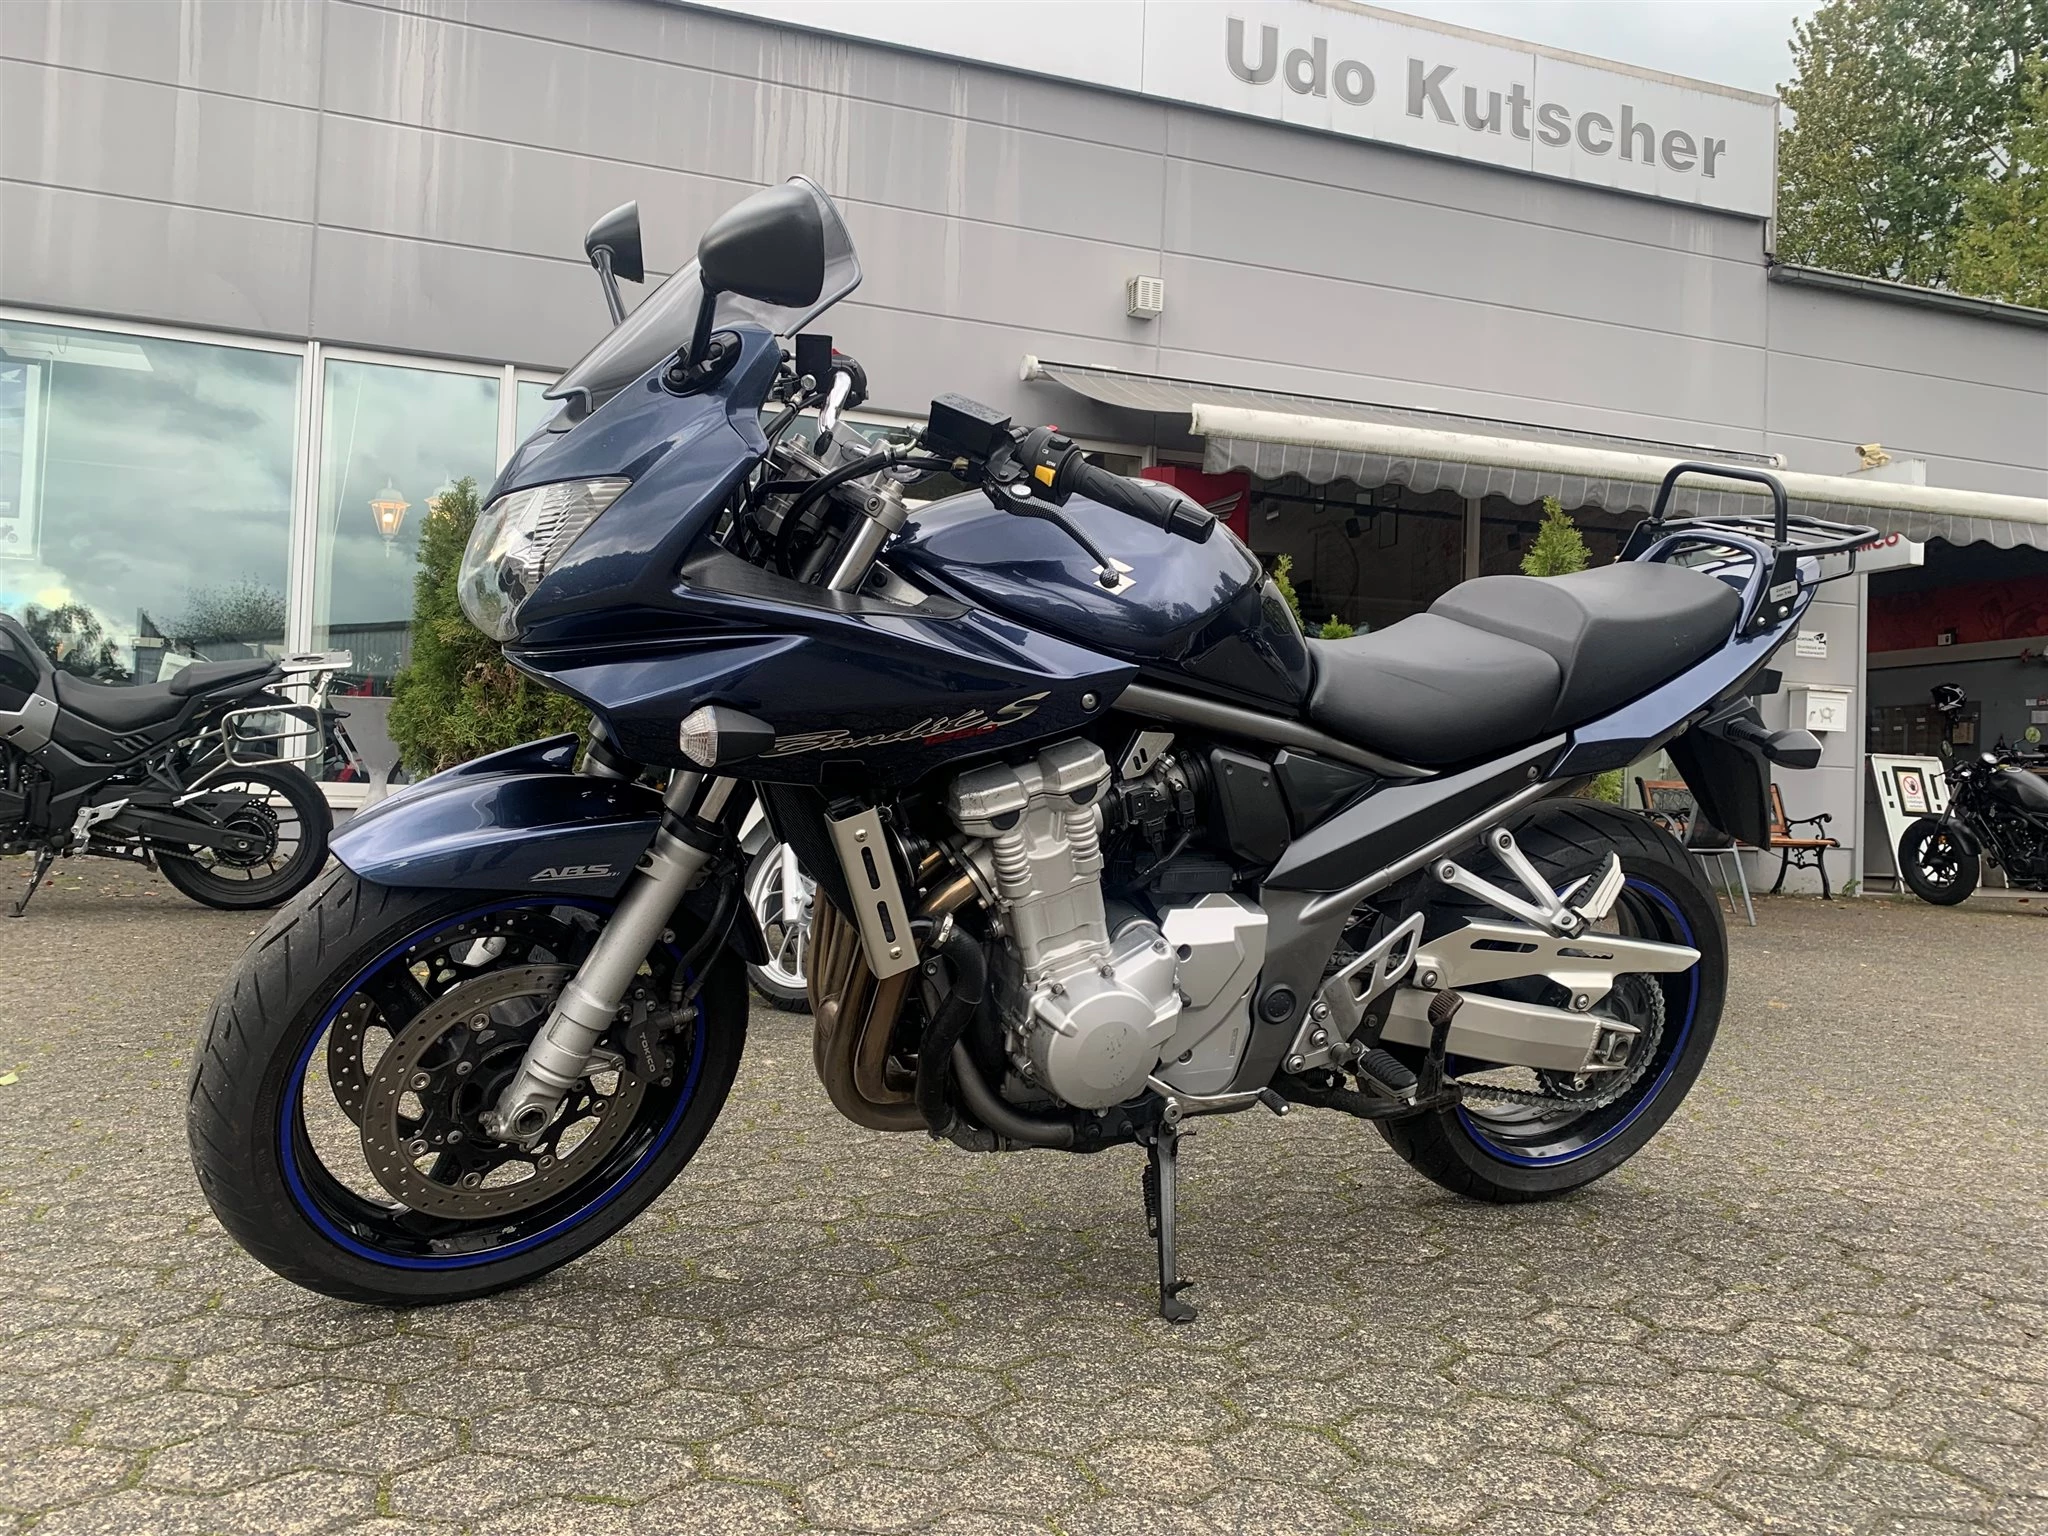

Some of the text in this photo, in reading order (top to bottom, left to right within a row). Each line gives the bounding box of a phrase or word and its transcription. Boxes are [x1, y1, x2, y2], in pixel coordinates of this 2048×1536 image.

[1224, 16, 1727, 178] Udo Kutscher
[758, 690, 1051, 757] Bandit S
[529, 863, 613, 881] ABS
[640, 1032, 656, 1073] TOKICO
